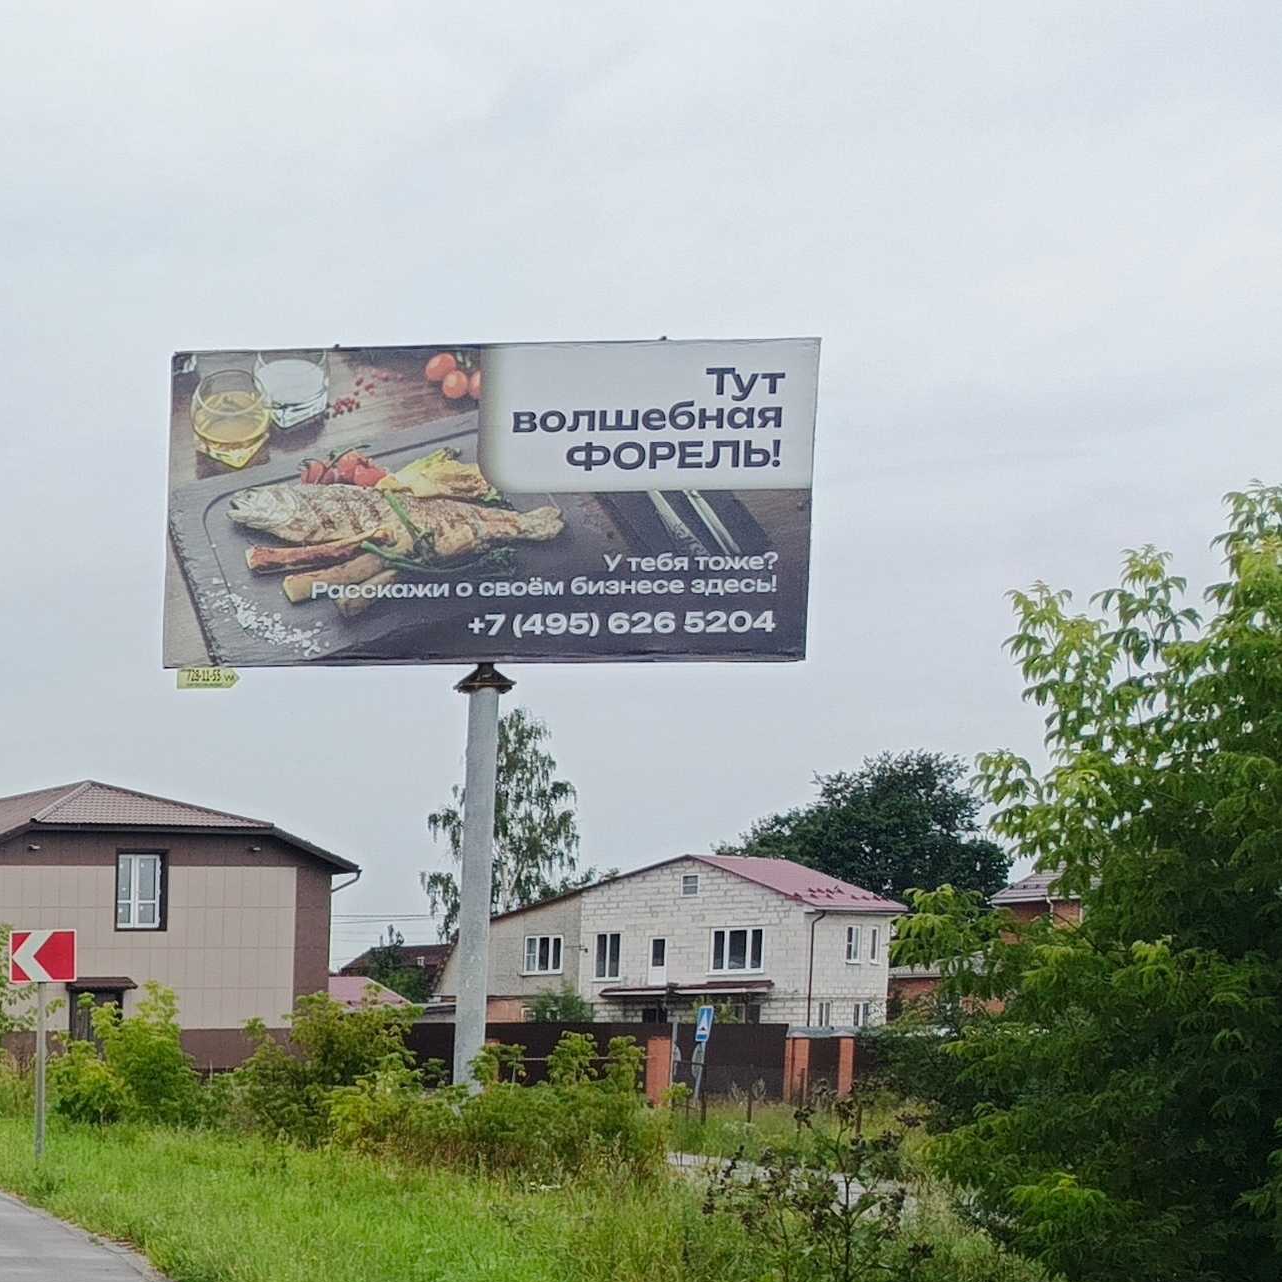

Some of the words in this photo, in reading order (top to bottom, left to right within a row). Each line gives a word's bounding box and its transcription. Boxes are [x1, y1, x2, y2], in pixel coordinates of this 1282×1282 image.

[705, 367, 786, 402] Тут
[511, 399, 783, 433] волшебная
[565, 439, 782, 472] ФОРЕЛЬ!
[603, 554, 623, 572] У
[626, 552, 689, 572] тебя
[694, 551, 780, 571] тоже?
[310, 581, 450, 600] Расскажи
[455, 582, 473, 597] о
[478, 577, 564, 597] своём
[570, 576, 685, 596] бизнесе
[690, 574, 778, 597] здесь!
[468, 613, 506, 636] +7
[512, 611, 600, 639] (495)
[607, 611, 676, 635] 626
[683, 610, 777, 634] 5204
